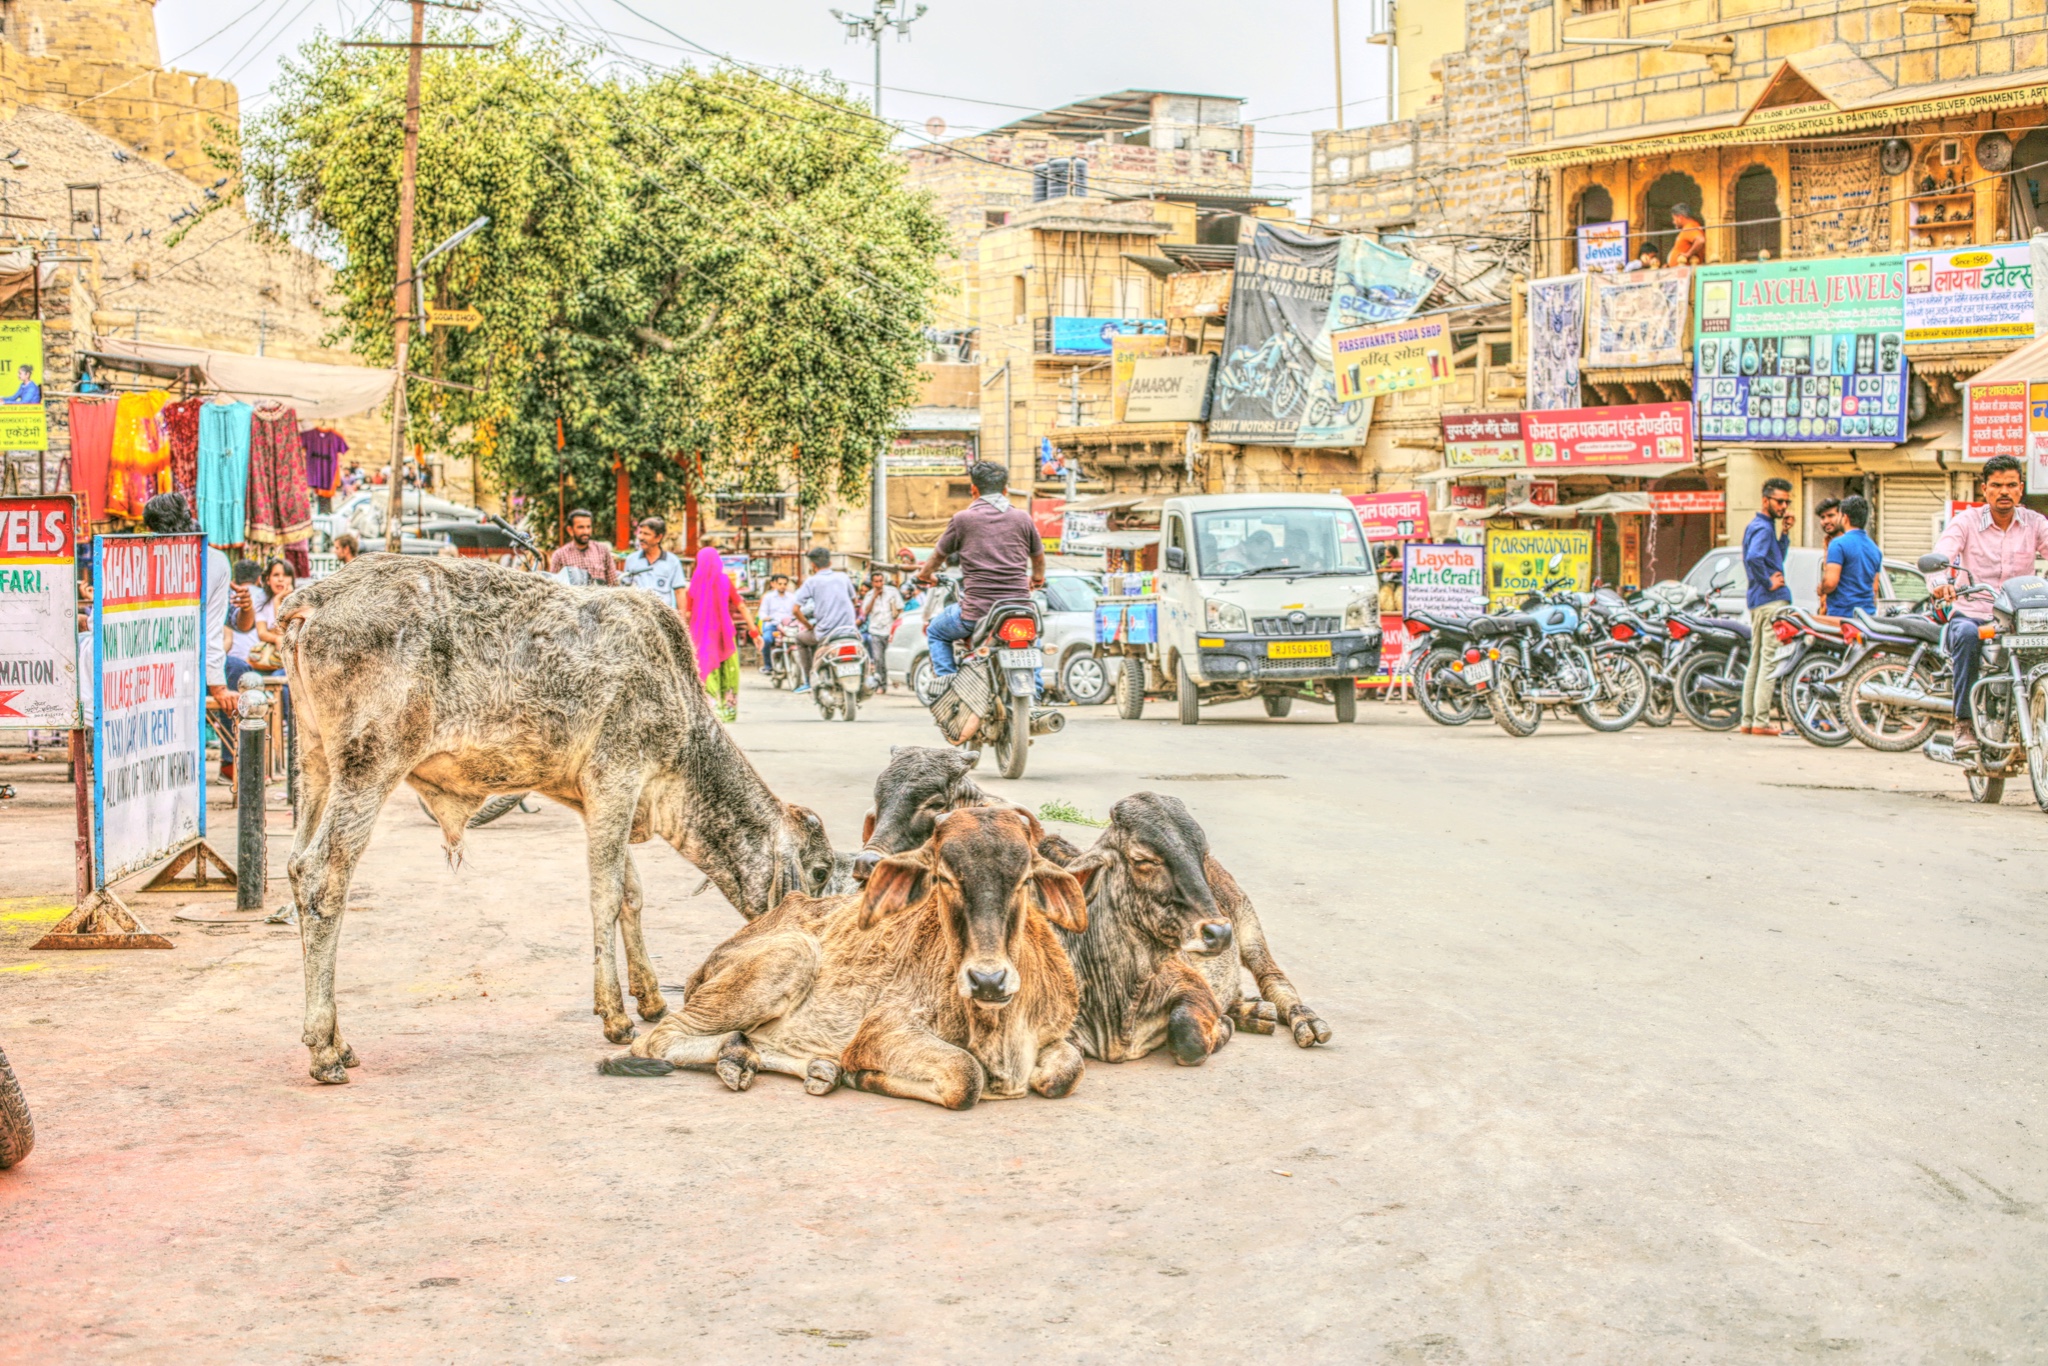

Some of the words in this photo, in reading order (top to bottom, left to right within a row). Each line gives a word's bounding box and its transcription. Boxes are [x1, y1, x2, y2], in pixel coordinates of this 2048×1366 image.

[1798, 116, 1834, 130] ARTICALS
[1837, 114, 1844, 125] &
[1585, 242, 1623, 260] Jewels
[1934, 268, 1983, 291] लायचा
[1737, 276, 1820, 307] LAYCHA
[1823, 272, 1903, 309] JEWELS
[1338, 332, 1397, 353] PARSHVANATH
[1398, 327, 1419, 343] SODA
[1420, 324, 1442, 339] SHOP
[1131, 377, 1181, 394] AMARON
[1211, 420, 1239, 432] SUMIT
[1240, 420, 1276, 432] MOTORS
[1528, 418, 1559, 440] फेमस
[1558, 422, 1579, 442] दाल
[1579, 420, 1618, 439] पकवान
[1379, 501, 1421, 519] पकवान
[1492, 537, 1588, 554] PARSHVANATH
[1415, 548, 1474, 571] Laycha
[102, 545, 148, 600] SAHARA
[154, 543, 198, 595] TRAVELS
[1408, 567, 1432, 585] Art
[1441, 568, 1481, 585] Craft
[1504, 577, 1538, 588] SODA
[153, 616, 177, 654] CAMEL
[103, 668, 133, 711] VILLAGE
